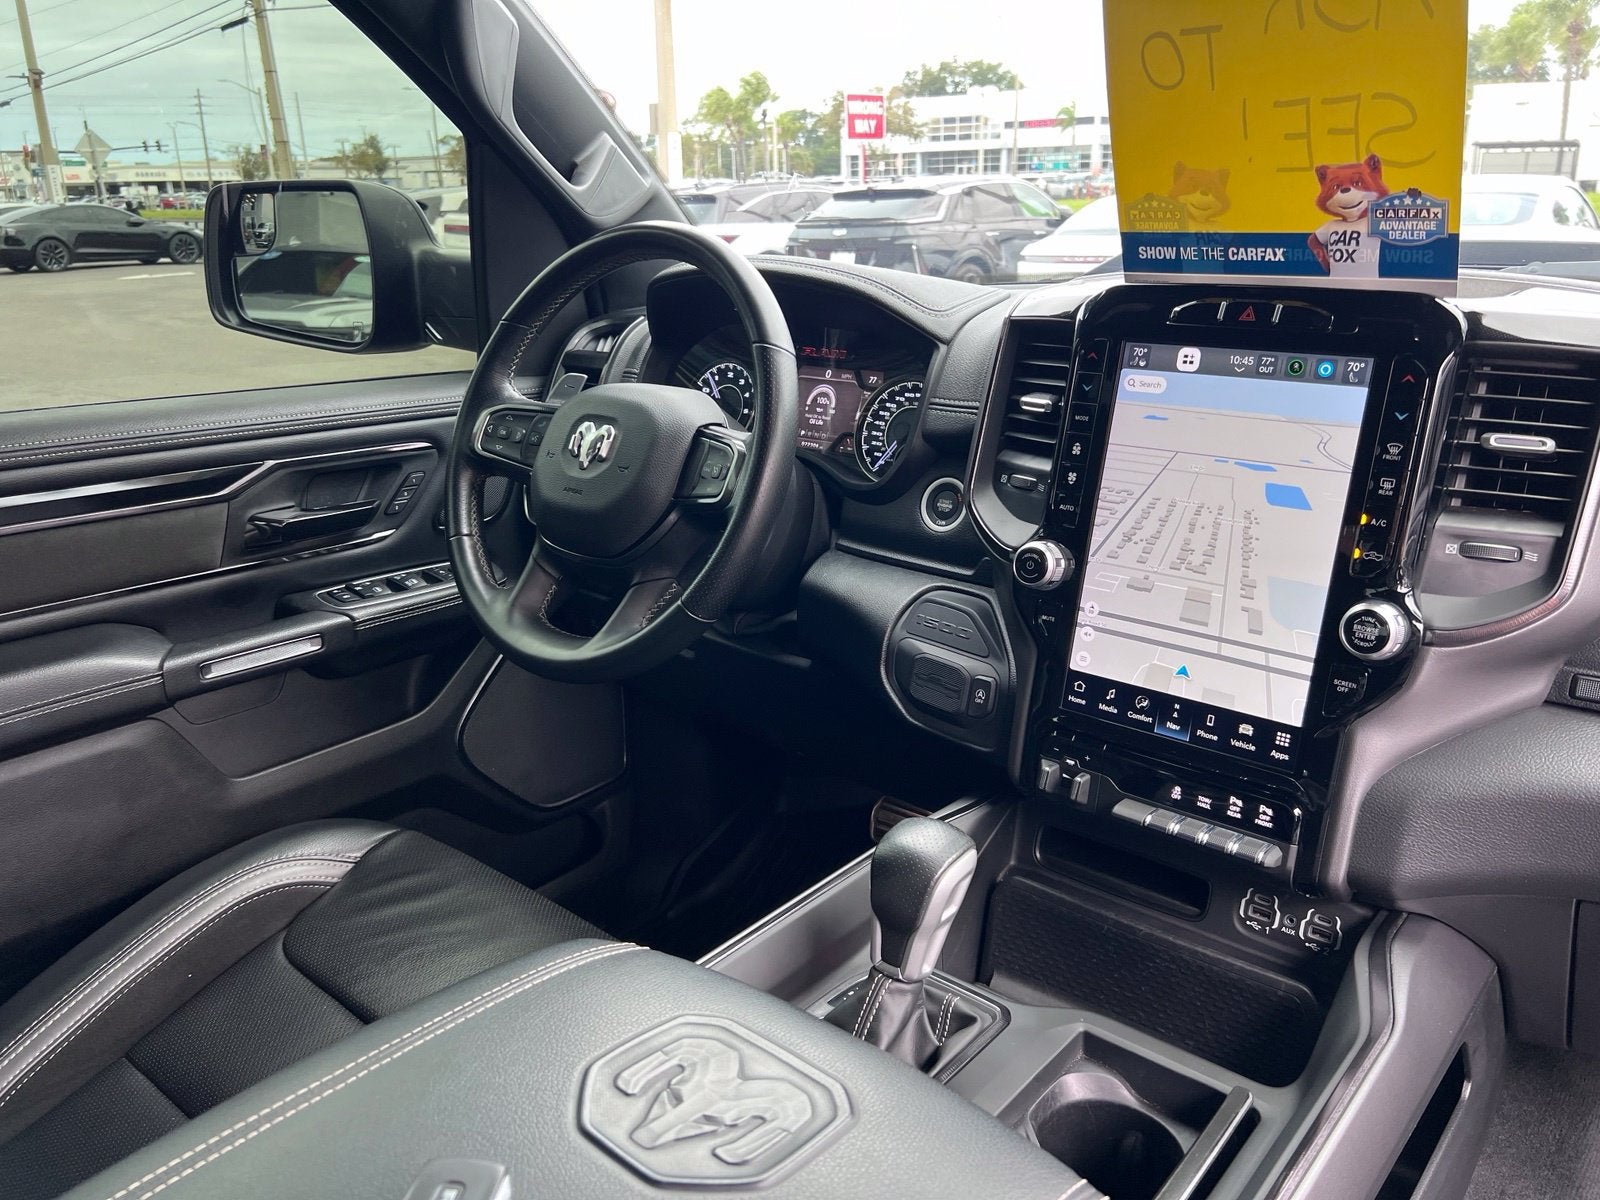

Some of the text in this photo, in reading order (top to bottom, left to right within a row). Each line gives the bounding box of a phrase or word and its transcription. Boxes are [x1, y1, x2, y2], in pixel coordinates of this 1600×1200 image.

[854, 119, 877, 133] WAY
[1375, 209, 1442, 219] CARFAX
[1379, 221, 1437, 231] ADVANTAGE
[1329, 230, 1361, 247] CAR
[1389, 230, 1426, 240] DEALER
[1138, 246, 1285, 262] SHOW ME THE CARFAX
[1229, 354, 1254, 366] 10:45
[826, 369, 832, 379] 0
[1258, 366, 1274, 374] OUT
[1138, 380, 1162, 390] Search
[1370, 518, 1387, 527] A/C
[1041, 614, 1055, 622] MUTE
[1361, 616, 1377, 624] TUNE
[916, 613, 974, 640] 1500
[1353, 624, 1380, 633] BROWSE
[1354, 632, 1376, 641] ENTER
[1353, 639, 1374, 648] SCROLL
[1333, 678, 1358, 689] SCREEN
[1068, 694, 1290, 762] Home Media Comfort Nav Phone Vehicle Apps
[1229, 804, 1241, 812] OFF
[1226, 809, 1242, 819] REAR
[1258, 813, 1272, 821] OFF
[1254, 818, 1275, 829] FRONT
[1264, 926, 1296, 936] 1 AUX
